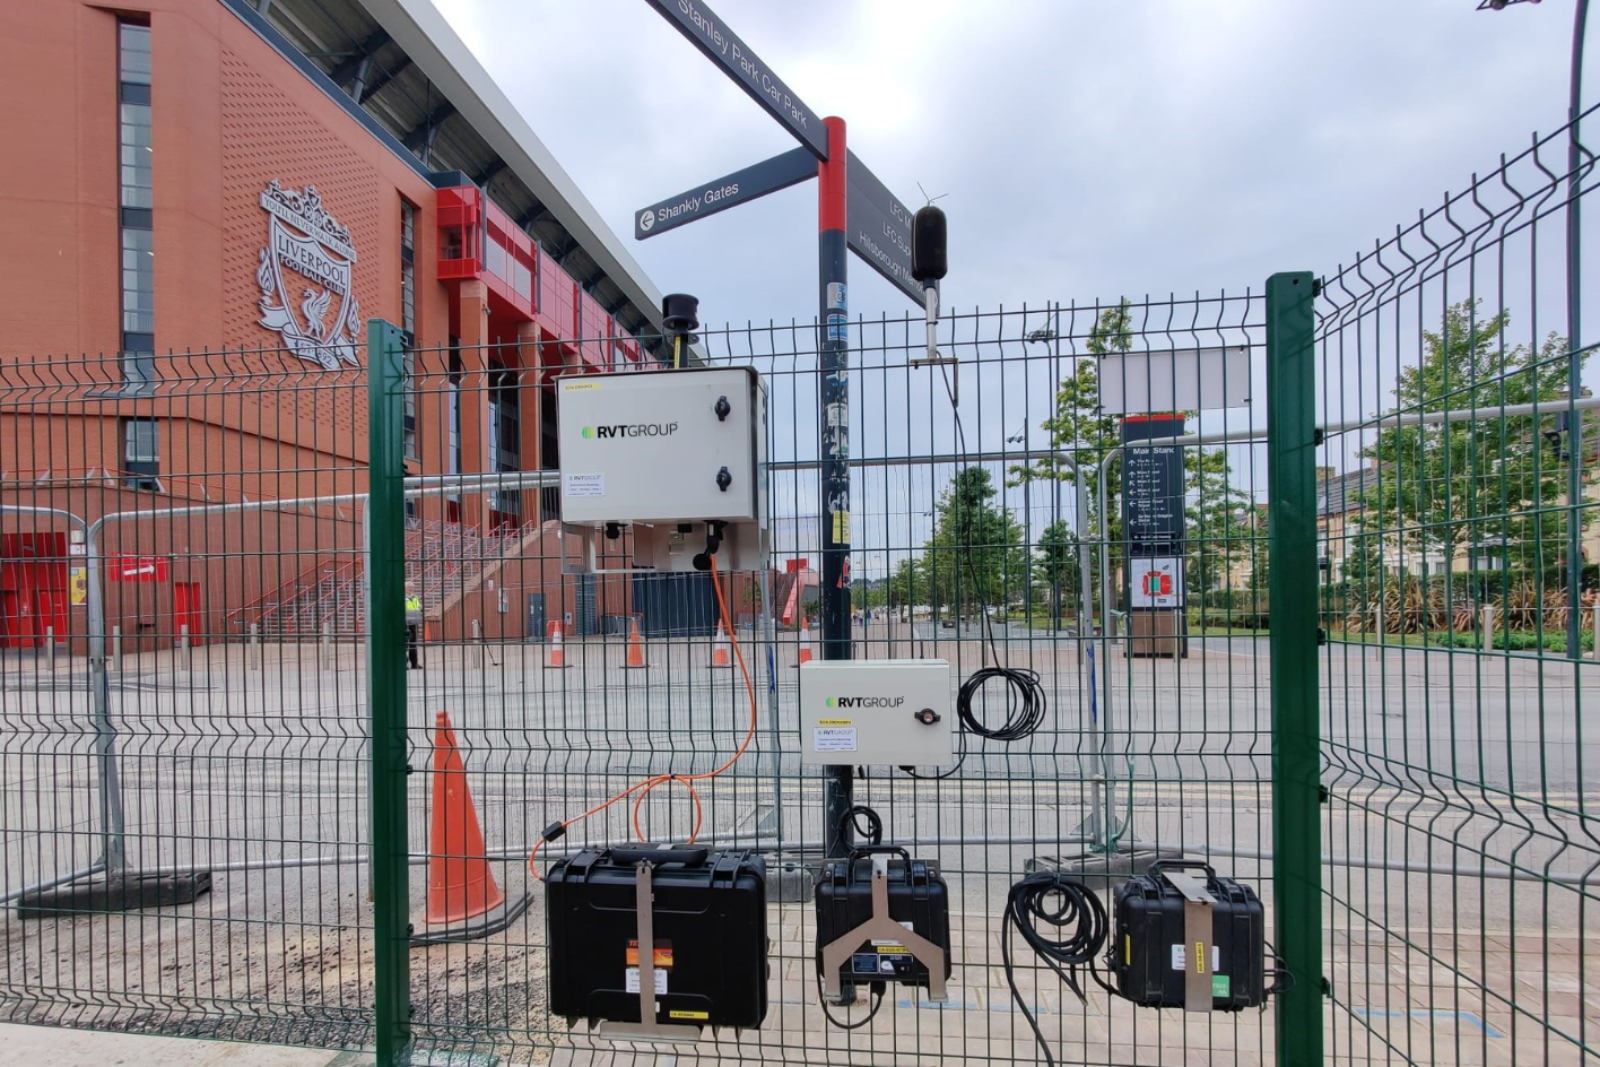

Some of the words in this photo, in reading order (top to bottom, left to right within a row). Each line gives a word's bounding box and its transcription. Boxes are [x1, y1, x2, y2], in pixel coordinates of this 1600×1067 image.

[677, 0, 729, 55] Stanley
[732, 42, 759, 83] Park
[762, 74, 781, 102] Car
[784, 94, 808, 129] Park
[658, 196, 702, 222] Shankly
[704, 183, 739, 204] Gates
[889, 199, 904, 222] LFC
[290, 213, 316, 236] NEVER
[313, 228, 335, 248] WALK
[883, 221, 897, 243] LFC
[278, 235, 346, 287] LIVERPOOL
[859, 230, 902, 276] Hillsborough
[597, 423, 678, 439] RVTGROUP
[838, 697, 904, 708] RVTGROUP
